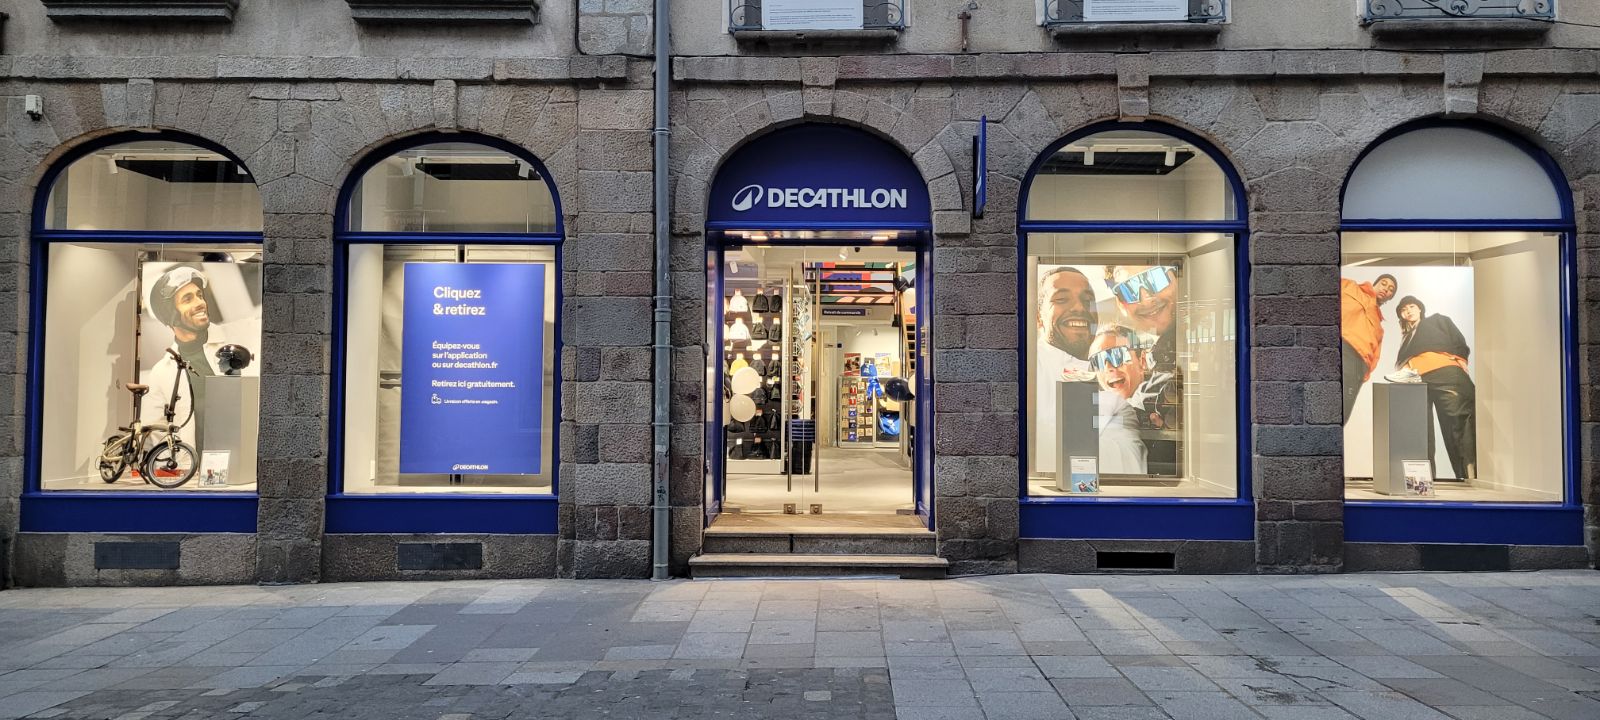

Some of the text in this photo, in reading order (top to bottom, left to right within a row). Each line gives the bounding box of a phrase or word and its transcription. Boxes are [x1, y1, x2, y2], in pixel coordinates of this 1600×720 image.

[767, 187, 907, 209] DECATHLON
[433, 286, 482, 301] Cliquez
[433, 303, 486, 316] & retirez
[432, 340, 480, 350] Équipez-vous
[444, 351, 488, 361] l'application
[454, 361, 498, 369] decathlon.fr
[466, 380, 516, 389] gratuitement.
